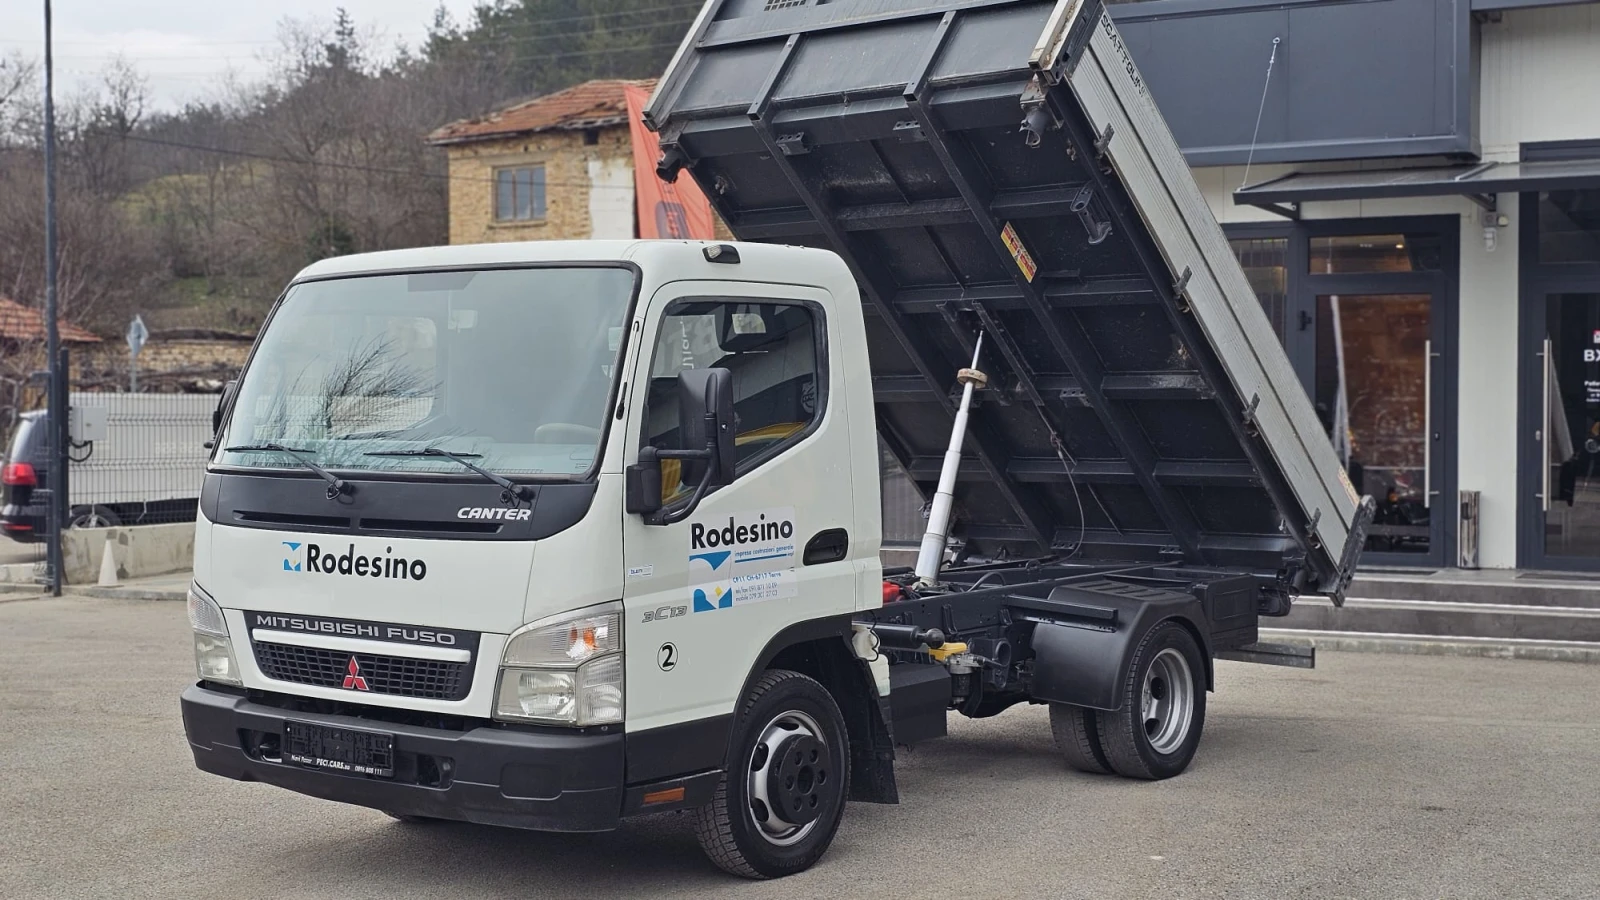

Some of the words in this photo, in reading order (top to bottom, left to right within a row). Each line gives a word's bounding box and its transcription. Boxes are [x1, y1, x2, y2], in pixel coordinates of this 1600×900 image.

[457, 507, 531, 521] CANTER
[691, 513, 793, 549] Rodesino
[306, 542, 427, 581] Rodesino
[641, 605, 688, 623] 3C13
[256, 614, 380, 638] MITSUBISHI
[387, 627, 456, 646] FUSO
[661, 644, 675, 668] 2
